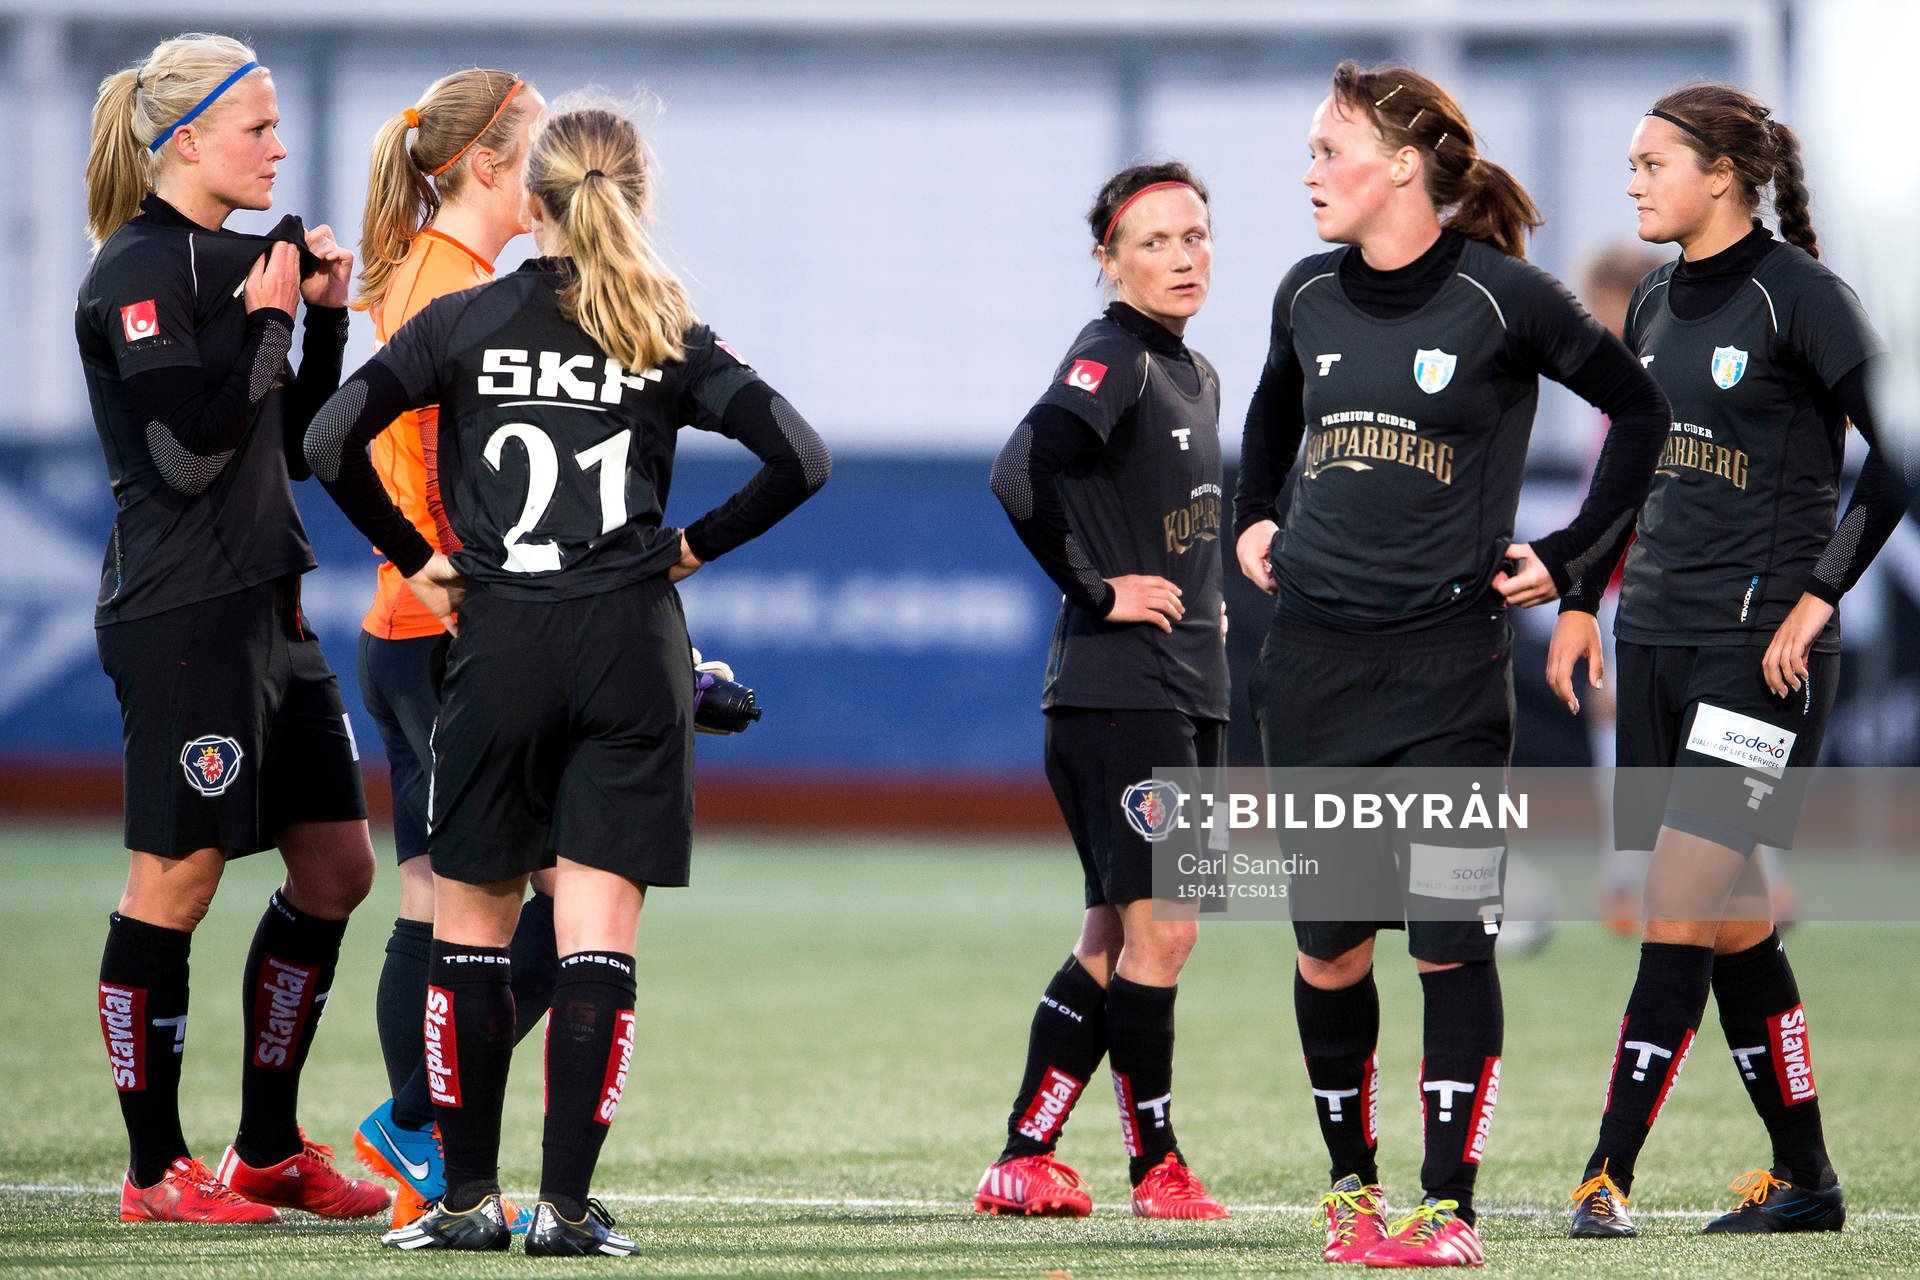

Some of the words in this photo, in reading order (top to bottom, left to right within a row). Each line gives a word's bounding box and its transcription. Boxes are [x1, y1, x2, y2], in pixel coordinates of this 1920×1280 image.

[477, 348, 663, 405] SKF
[1321, 410, 1374, 427] PREMIUM
[1377, 412, 1417, 431] CIDER
[1683, 422, 1713, 439] CIDER
[1304, 424, 1455, 486] KOPPARBERG
[1658, 435, 1749, 491] ARBERG
[481, 422, 632, 574] 21
[1718, 744, 1729, 753] OF
[1729, 746, 1748, 759] LIFE
[1748, 753, 1780, 770] SERVICES
[1722, 730, 1785, 759] sodexo
[100, 985, 137, 1089] Stavdal
[258, 958, 309, 1067] Stavdal
[427, 989, 457, 1105] Stavdal
[1779, 1007, 1815, 1101] Stavdal
